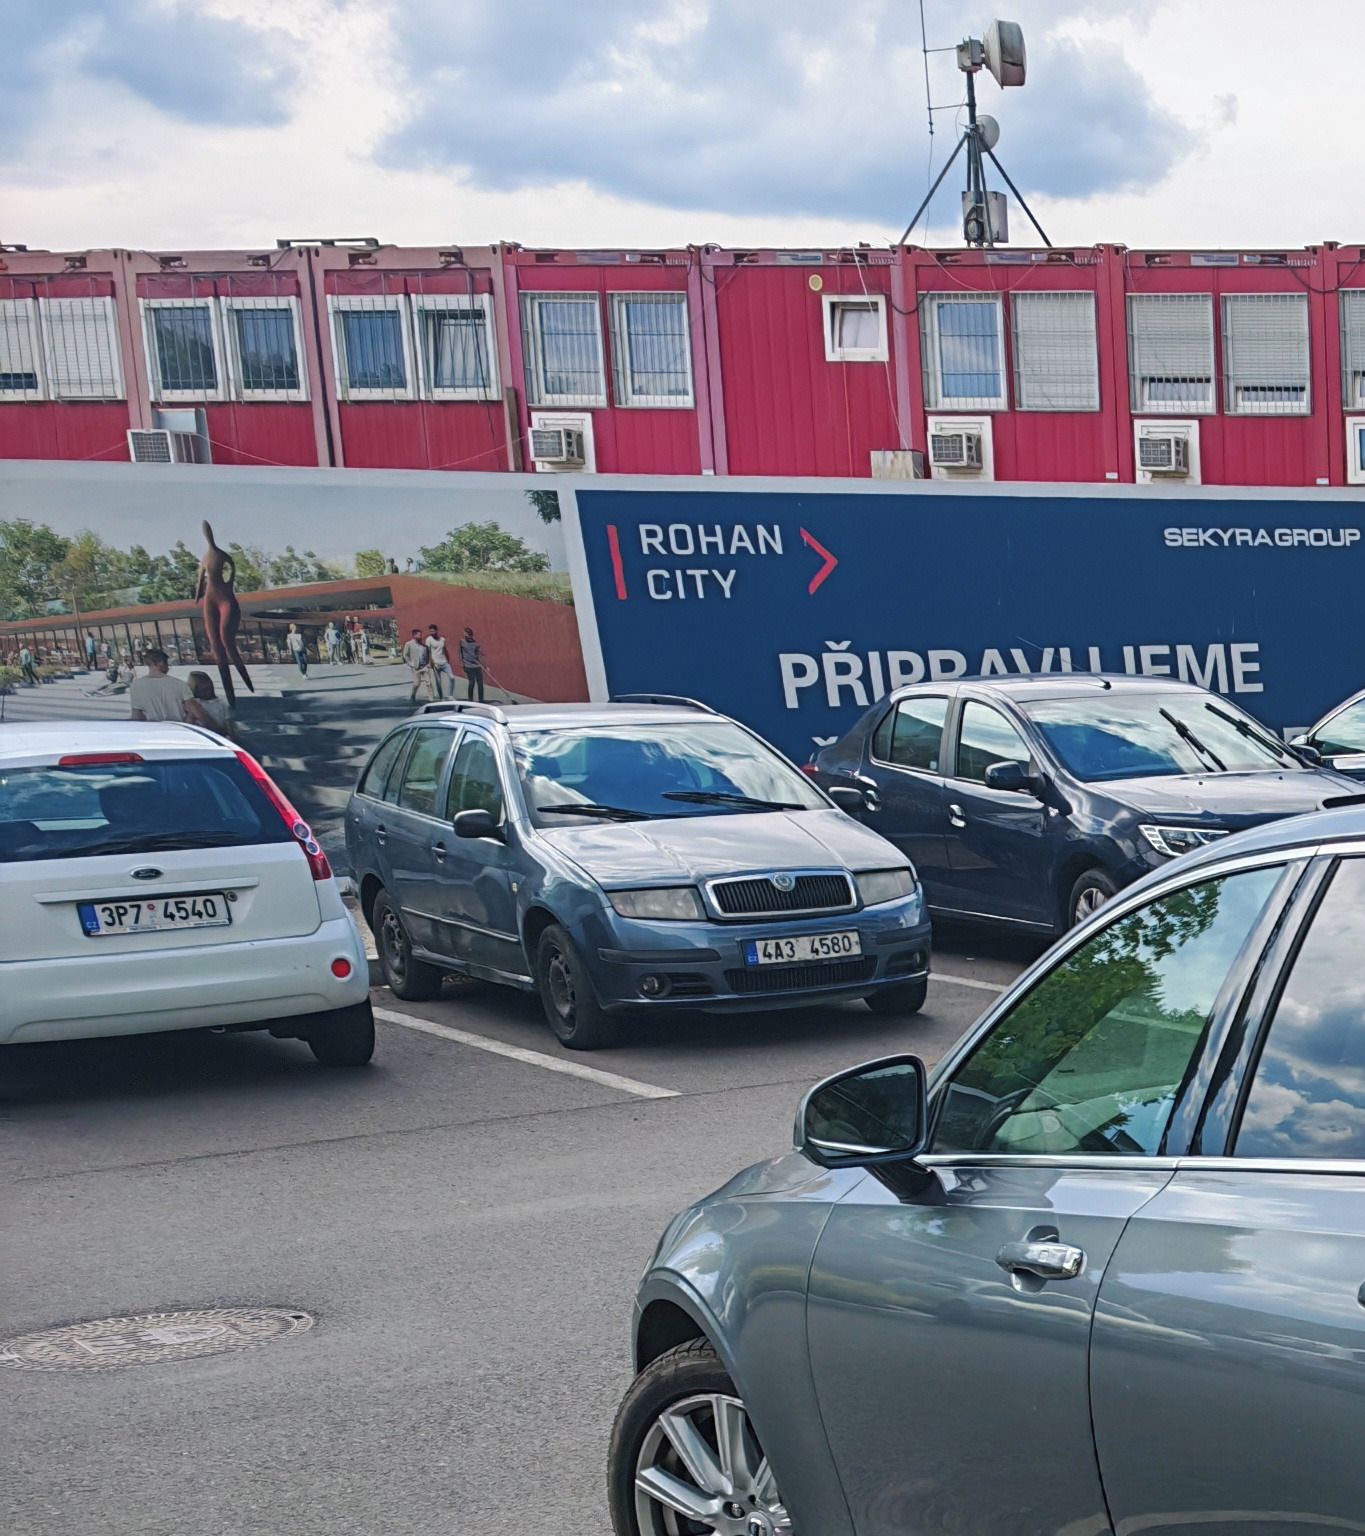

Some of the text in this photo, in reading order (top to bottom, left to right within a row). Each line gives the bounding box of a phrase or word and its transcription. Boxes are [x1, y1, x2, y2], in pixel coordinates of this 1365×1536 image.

[638, 523, 784, 555] ROHAN
[646, 569, 737, 600] CITY
[100, 903, 142, 927] 3P7
[163, 898, 217, 922] 4540
[762, 941, 796, 961] 4A3
[810, 934, 853, 956] 4580
